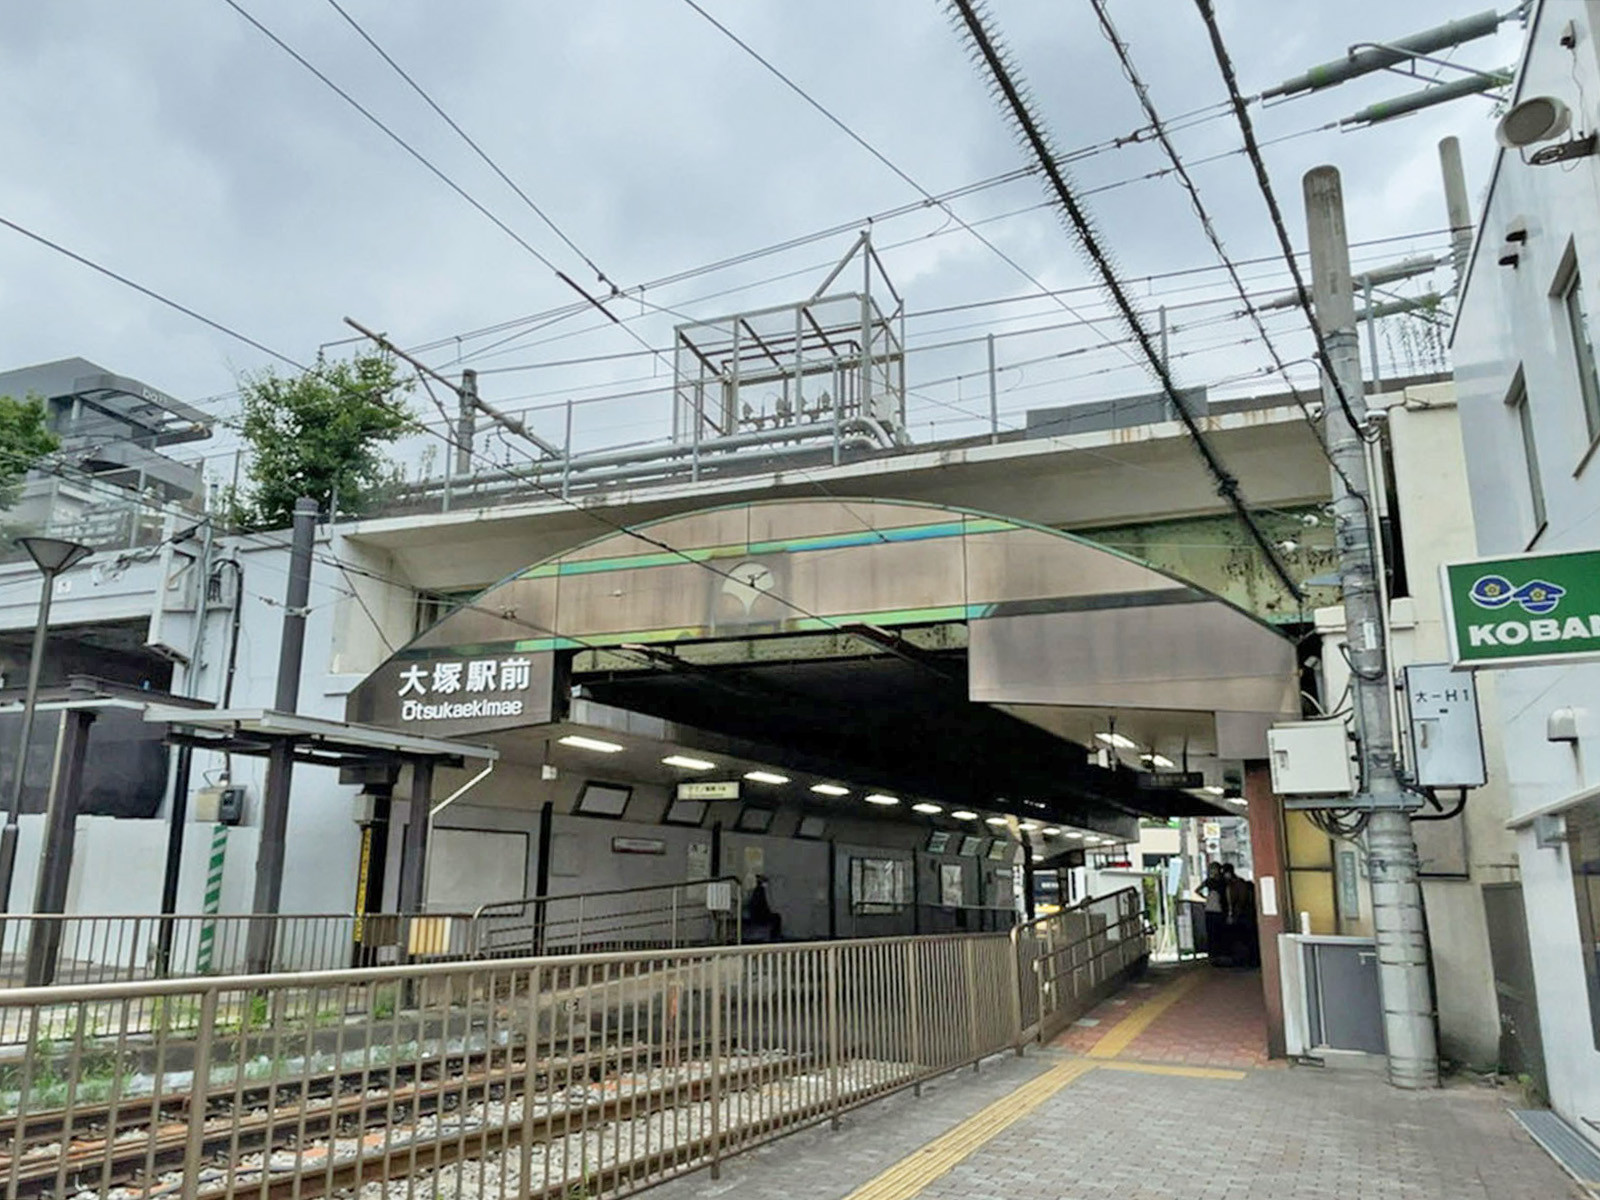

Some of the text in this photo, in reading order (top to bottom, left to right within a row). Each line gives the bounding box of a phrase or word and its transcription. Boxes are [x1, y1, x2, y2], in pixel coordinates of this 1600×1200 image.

[398, 657, 532, 697] 大塚駅前
[401, 699, 523, 721] Ōtsukaekimae
